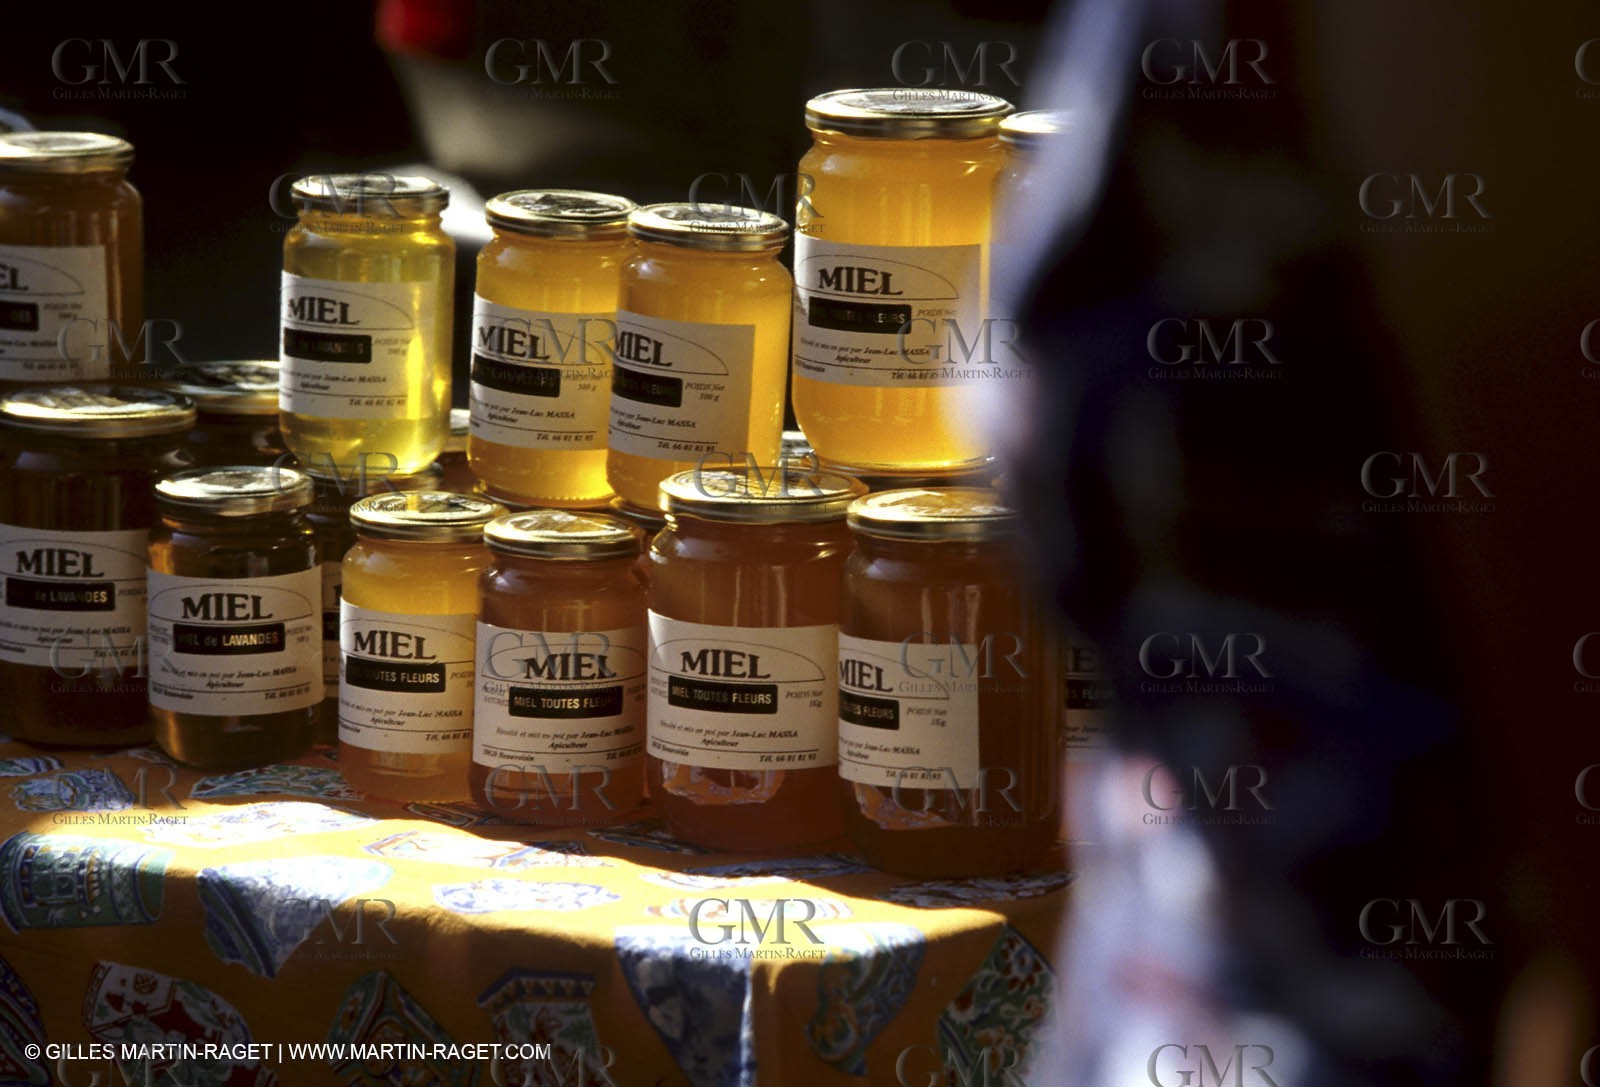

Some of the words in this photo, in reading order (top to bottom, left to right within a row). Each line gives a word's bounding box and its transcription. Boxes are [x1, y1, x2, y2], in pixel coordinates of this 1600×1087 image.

[817, 266, 904, 296] MIEL
[288, 296, 360, 326] MIEL
[477, 325, 550, 361] MIEL
[16, 548, 105, 578] MIEL
[181, 593, 273, 622] MIEL
[221, 631, 280, 647] LAVANDES
[353, 630, 437, 661] MIEL
[400, 672, 440, 684] FLEURS
[524, 653, 616, 682] MIEL
[680, 648, 771, 680] MIEL
[840, 658, 894, 693] MIEL
[513, 695, 537, 708] MIEL
[541, 697, 580, 710] TOUTES
[731, 691, 773, 705] FLEURS
